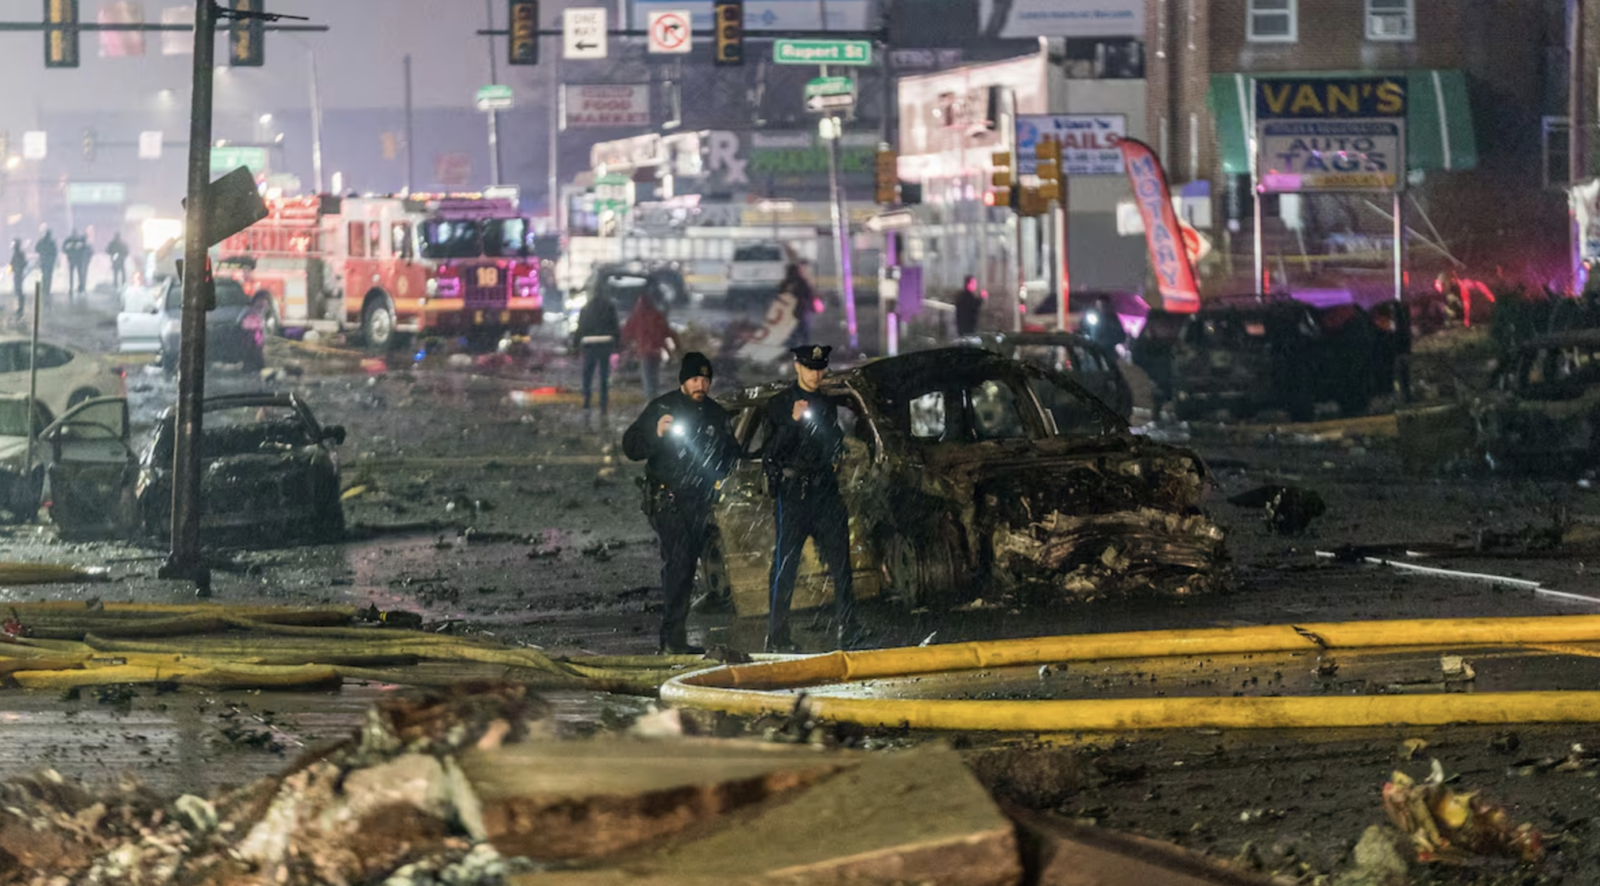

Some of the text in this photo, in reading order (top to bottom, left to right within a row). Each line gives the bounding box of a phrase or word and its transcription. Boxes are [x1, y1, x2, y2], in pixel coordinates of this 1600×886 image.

[574, 13, 598, 24] ONE
[574, 26, 598, 36] WAY
[782, 44, 864, 60] Rupert St
[1262, 82, 1404, 114] VAN'S
[1289, 137, 1376, 151] AUTO
[1276, 152, 1387, 173] TAGS
[1130, 154, 1177, 287] NOTARY
